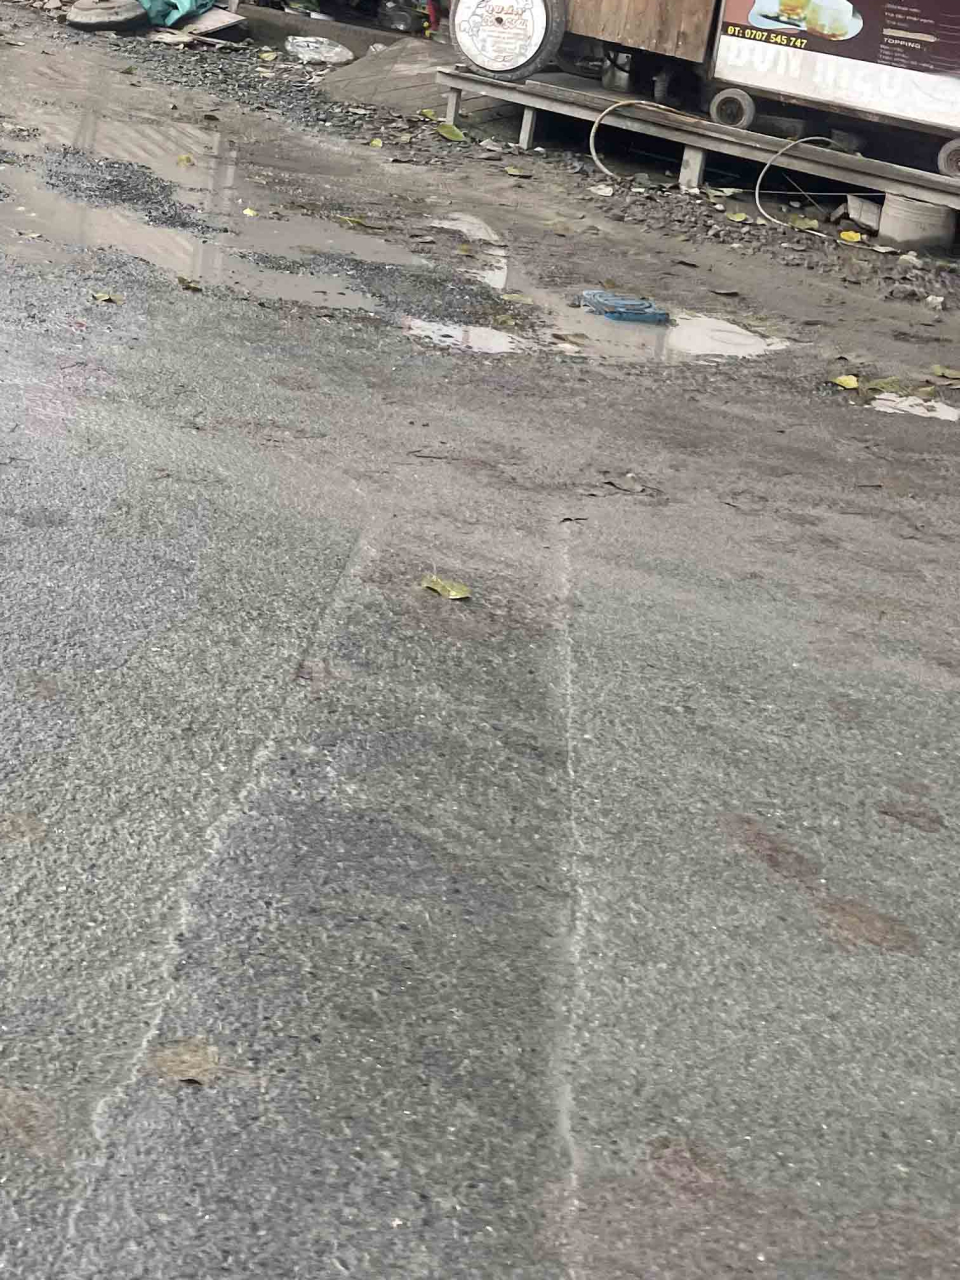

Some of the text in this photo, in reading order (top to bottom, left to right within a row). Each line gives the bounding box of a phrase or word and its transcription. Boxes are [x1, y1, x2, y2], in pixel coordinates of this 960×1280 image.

[744, 29, 769, 42] 0707
[770, 33, 788, 45] 545
[790, 37, 808, 49] 747
